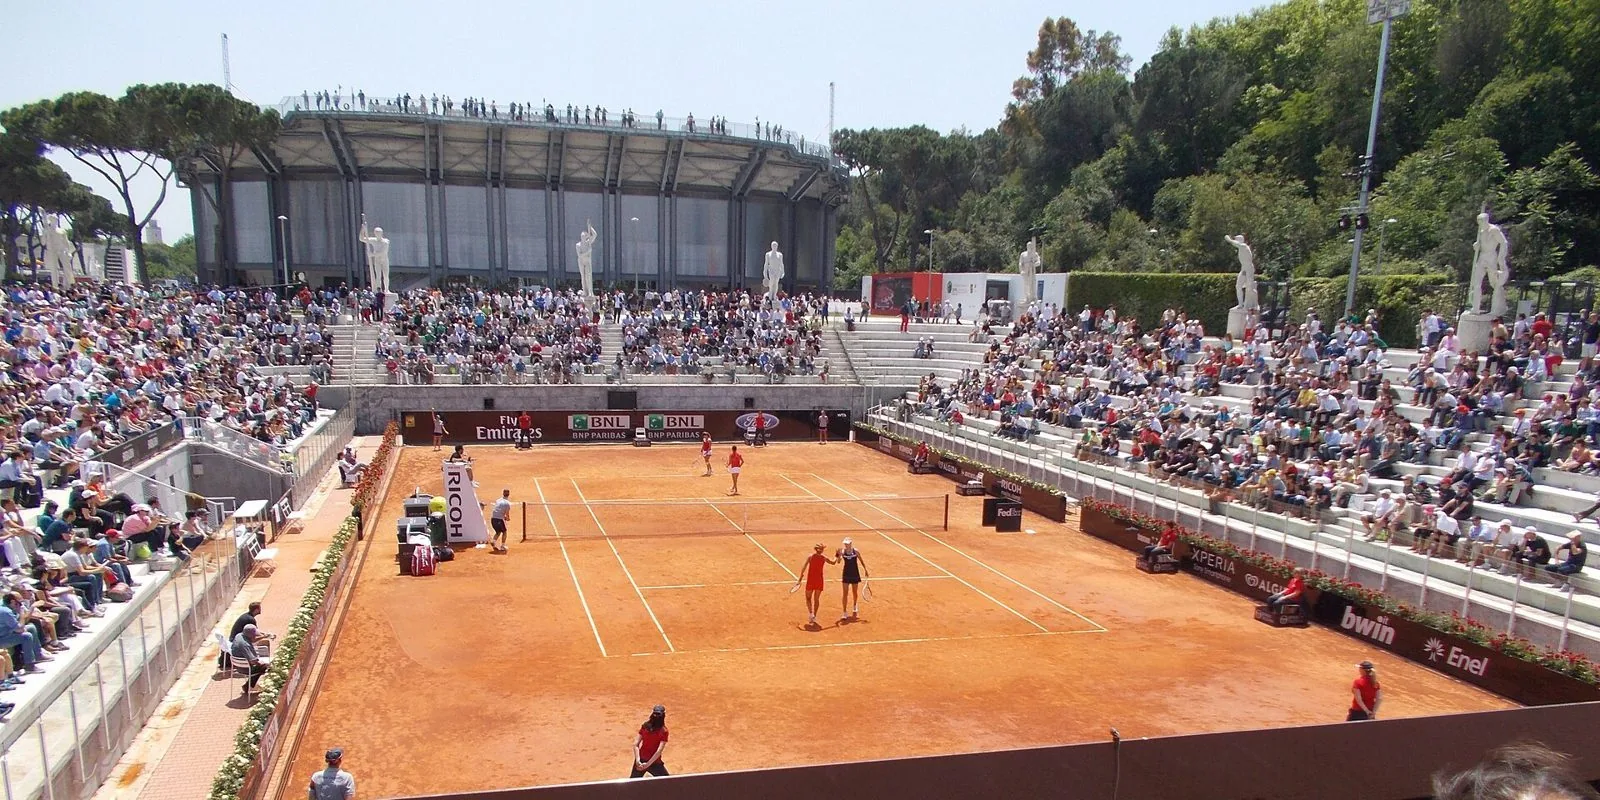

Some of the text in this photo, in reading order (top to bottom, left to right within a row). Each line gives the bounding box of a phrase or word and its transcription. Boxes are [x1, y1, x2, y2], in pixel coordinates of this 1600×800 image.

[500, 415, 517, 427] Fly
[591, 416, 626, 428] BNL
[666, 416, 700, 428] BNL
[476, 425, 542, 440] Emiraes
[591, 431, 626, 439] PARIBAS
[648, 431, 700, 439] BNP PARIBAS
[1000, 479, 1022, 494] RICOH
[448, 471, 463, 537] RICOH
[1191, 547, 1235, 575] XPERIA
[1340, 605, 1395, 645] bwin
[1446, 646, 1488, 676] Enel
